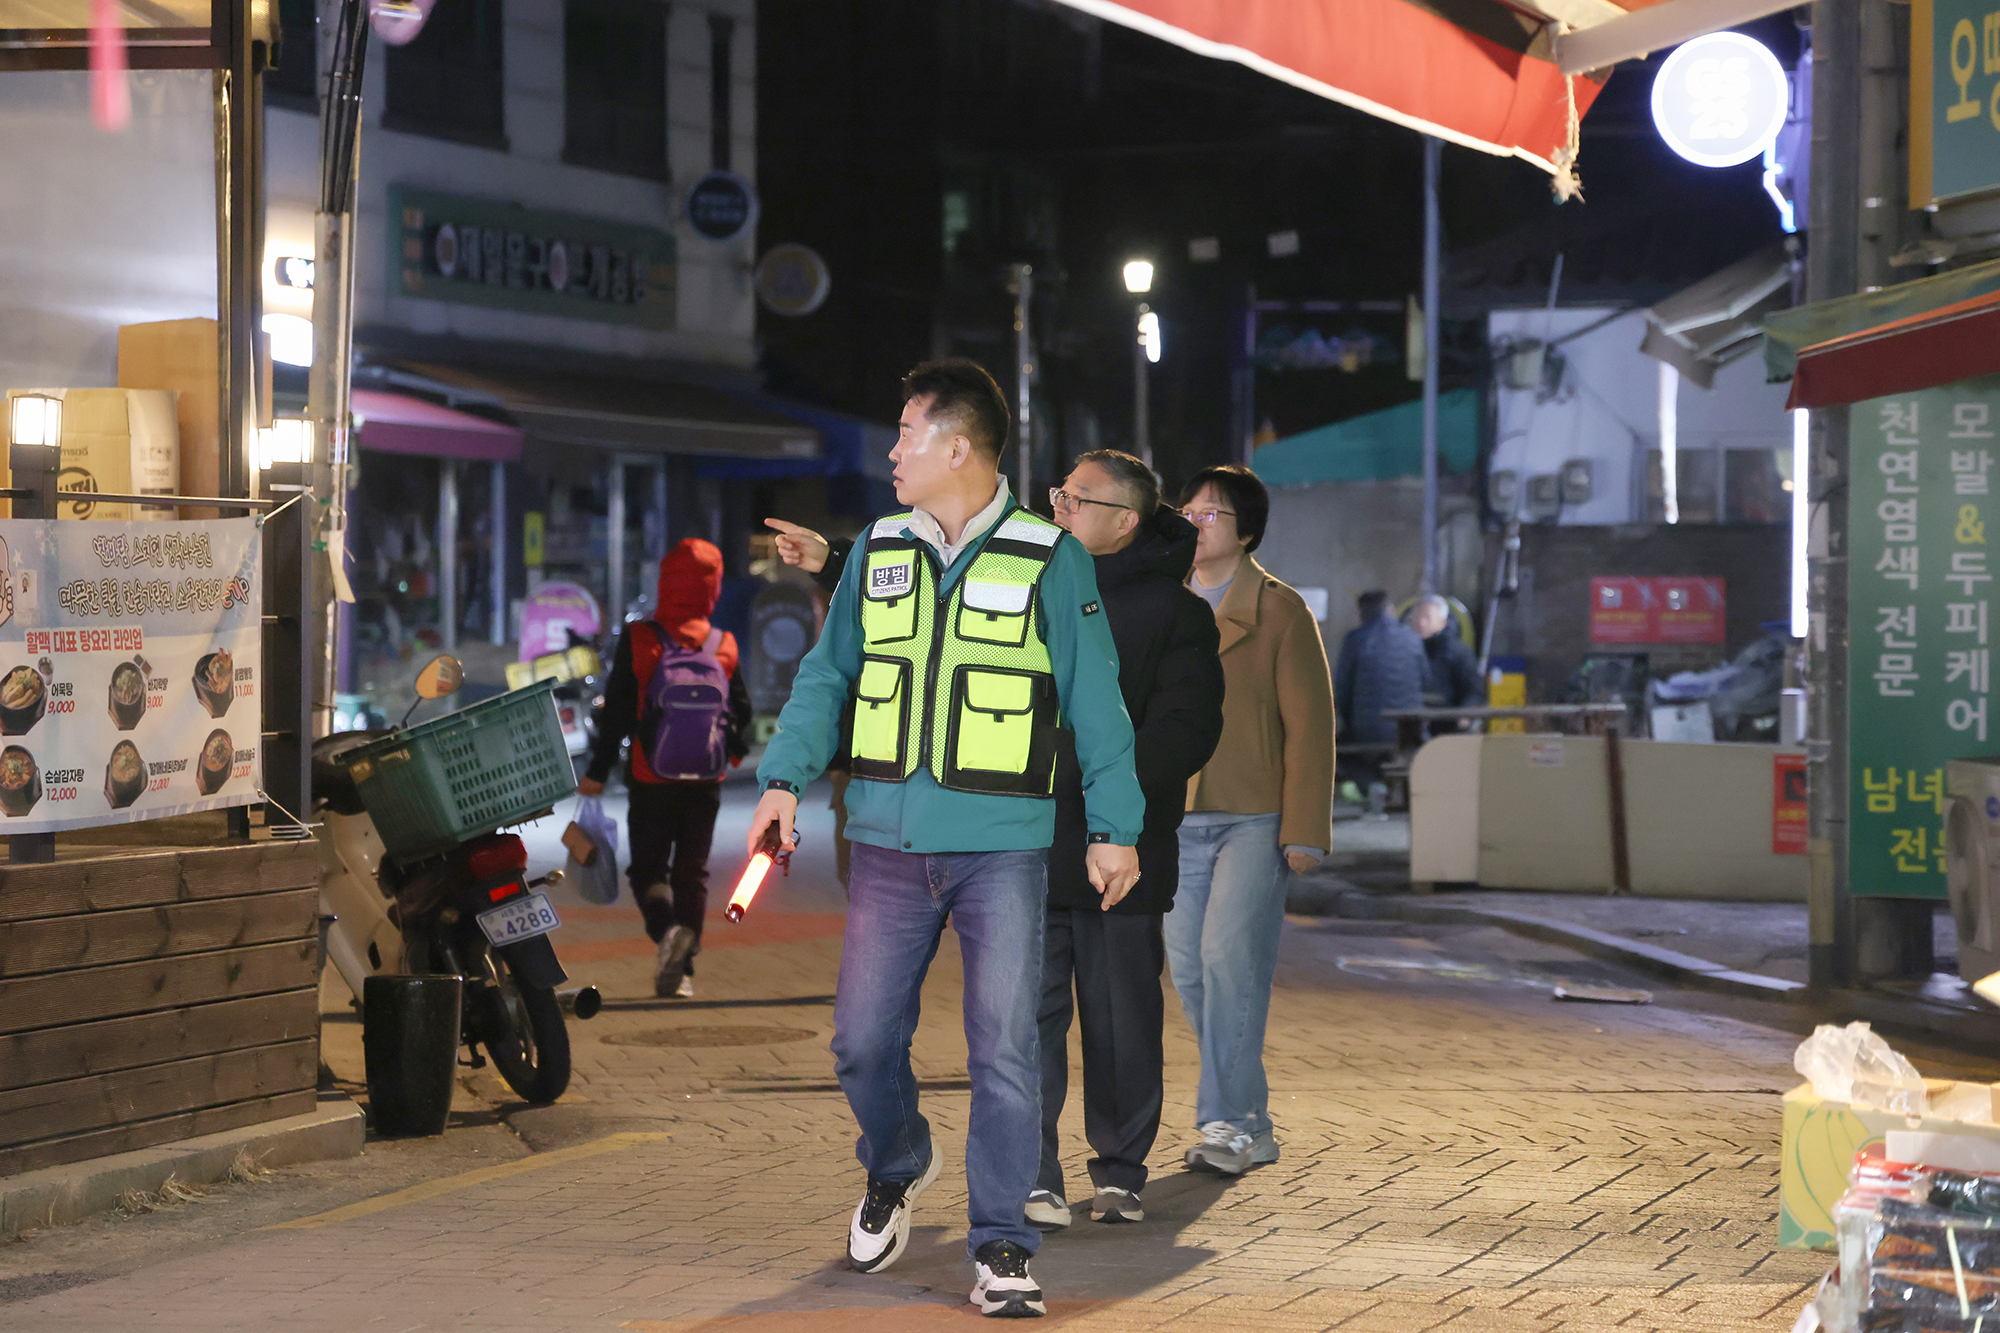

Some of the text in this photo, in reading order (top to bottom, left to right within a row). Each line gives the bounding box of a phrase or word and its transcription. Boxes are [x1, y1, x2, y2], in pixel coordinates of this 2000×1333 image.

[1685, 57, 1751, 99] GS
[1689, 97, 1748, 139] 25
[1872, 401, 1920, 698] 천연염색 전문
[876, 566, 905, 586] 방범
[871, 584, 908, 595] CITIZENS PATROL
[58, 579, 100, 617] 따뜻한
[26, 628, 143, 654] 할맥 대표 탕요리 라인업
[51, 682, 74, 697] 어묵탕
[234, 684, 254, 699] 11,000
[47, 700, 75, 714] 9,000
[147, 695, 164, 710] 9,000
[45, 768, 85, 784] 순살감자탕
[232, 765, 252, 780] 12,000
[148, 777, 170, 792] 12,000
[1864, 767, 1943, 814] 남녀
[45, 786, 77, 802] 12,000
[507, 908, 552, 935] 4288
